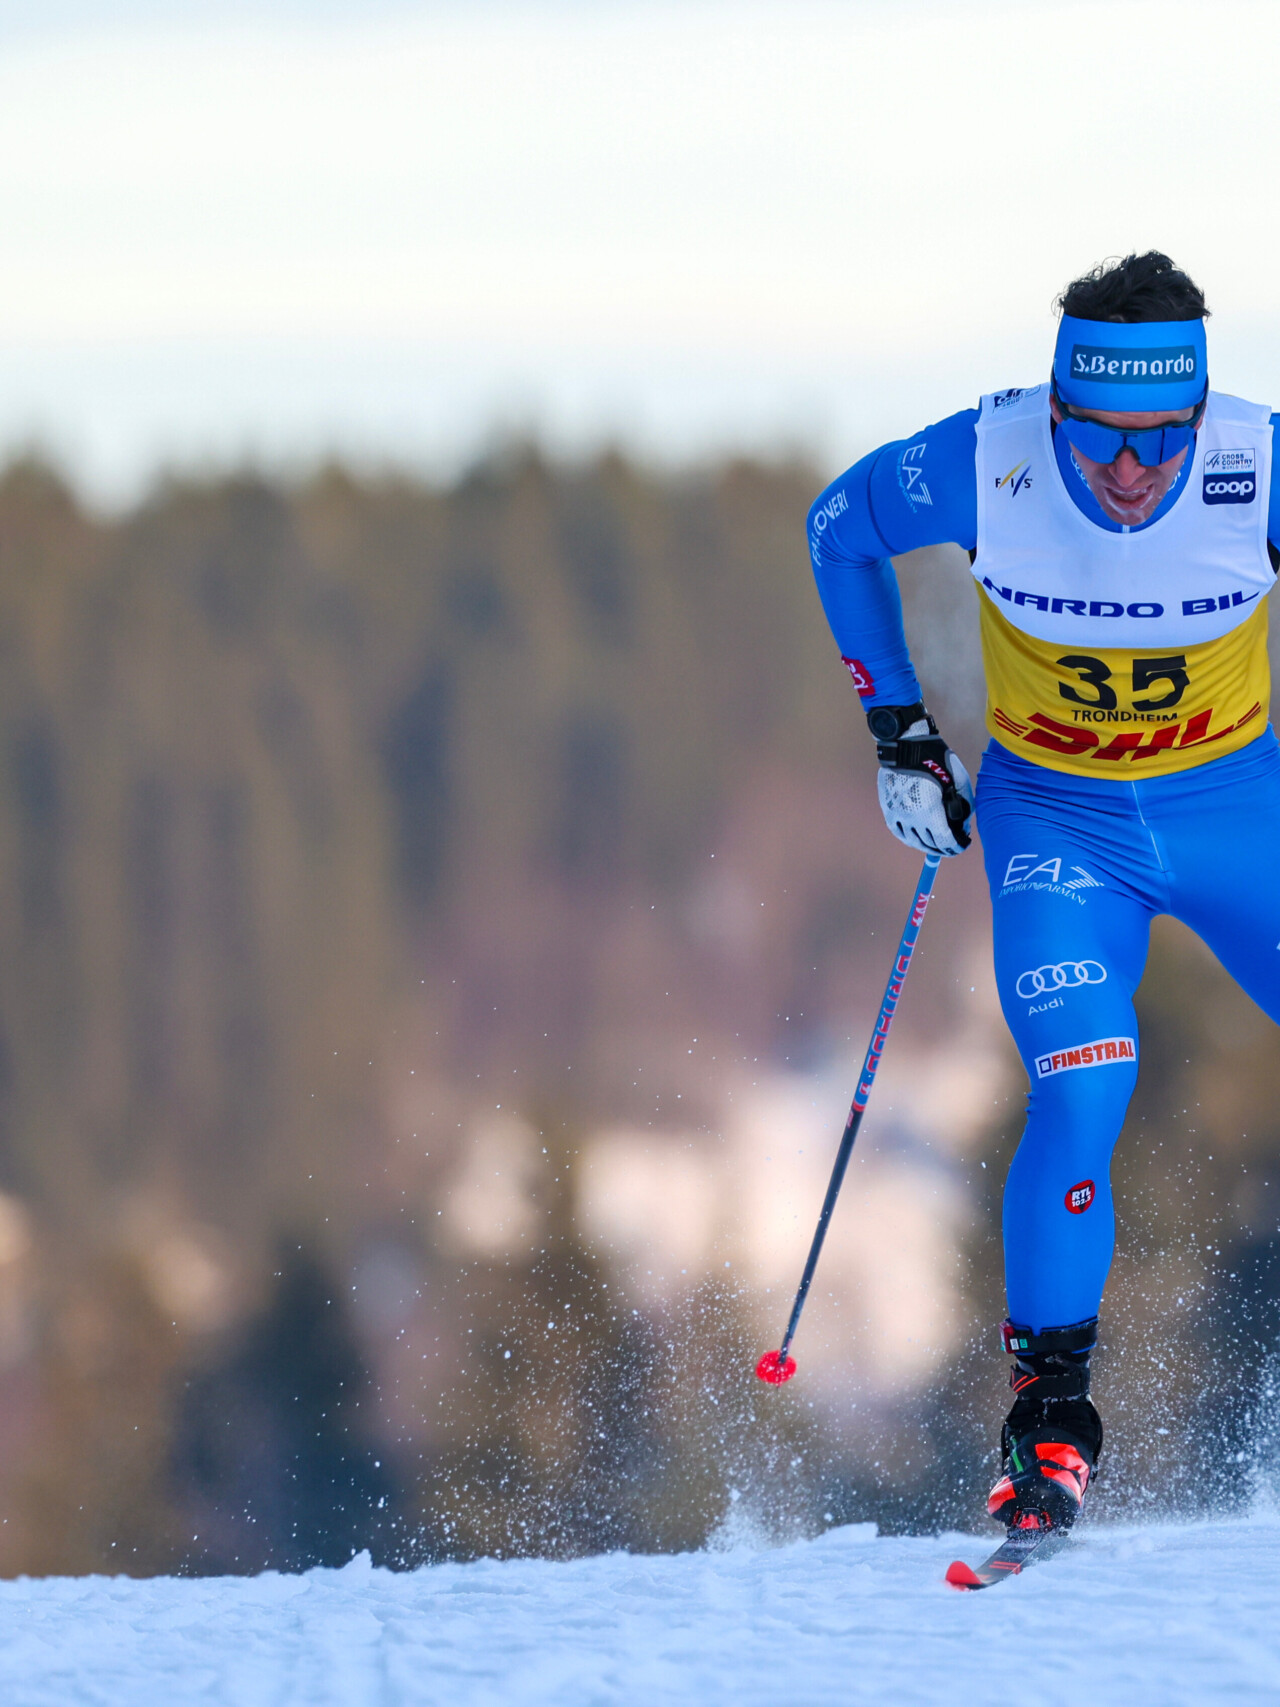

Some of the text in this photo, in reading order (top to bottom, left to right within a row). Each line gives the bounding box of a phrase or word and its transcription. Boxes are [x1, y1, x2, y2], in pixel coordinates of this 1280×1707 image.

[1074, 353, 1195, 376] S.Bernardo
[902, 443, 933, 506] EA7
[1205, 480, 1254, 496] coop
[982, 576, 1261, 619] NARDO BIL
[1056, 654, 1191, 712] 35
[1071, 709, 1178, 723] TRONDHEIM
[1022, 707, 1235, 762] DHL
[1003, 853, 1105, 890] EA7
[1028, 997, 1065, 1017] Audi
[1052, 1041, 1134, 1070] FINSTRAL
[1071, 1186, 1092, 1201] RTL
[1071, 1195, 1092, 1208] 102.5
